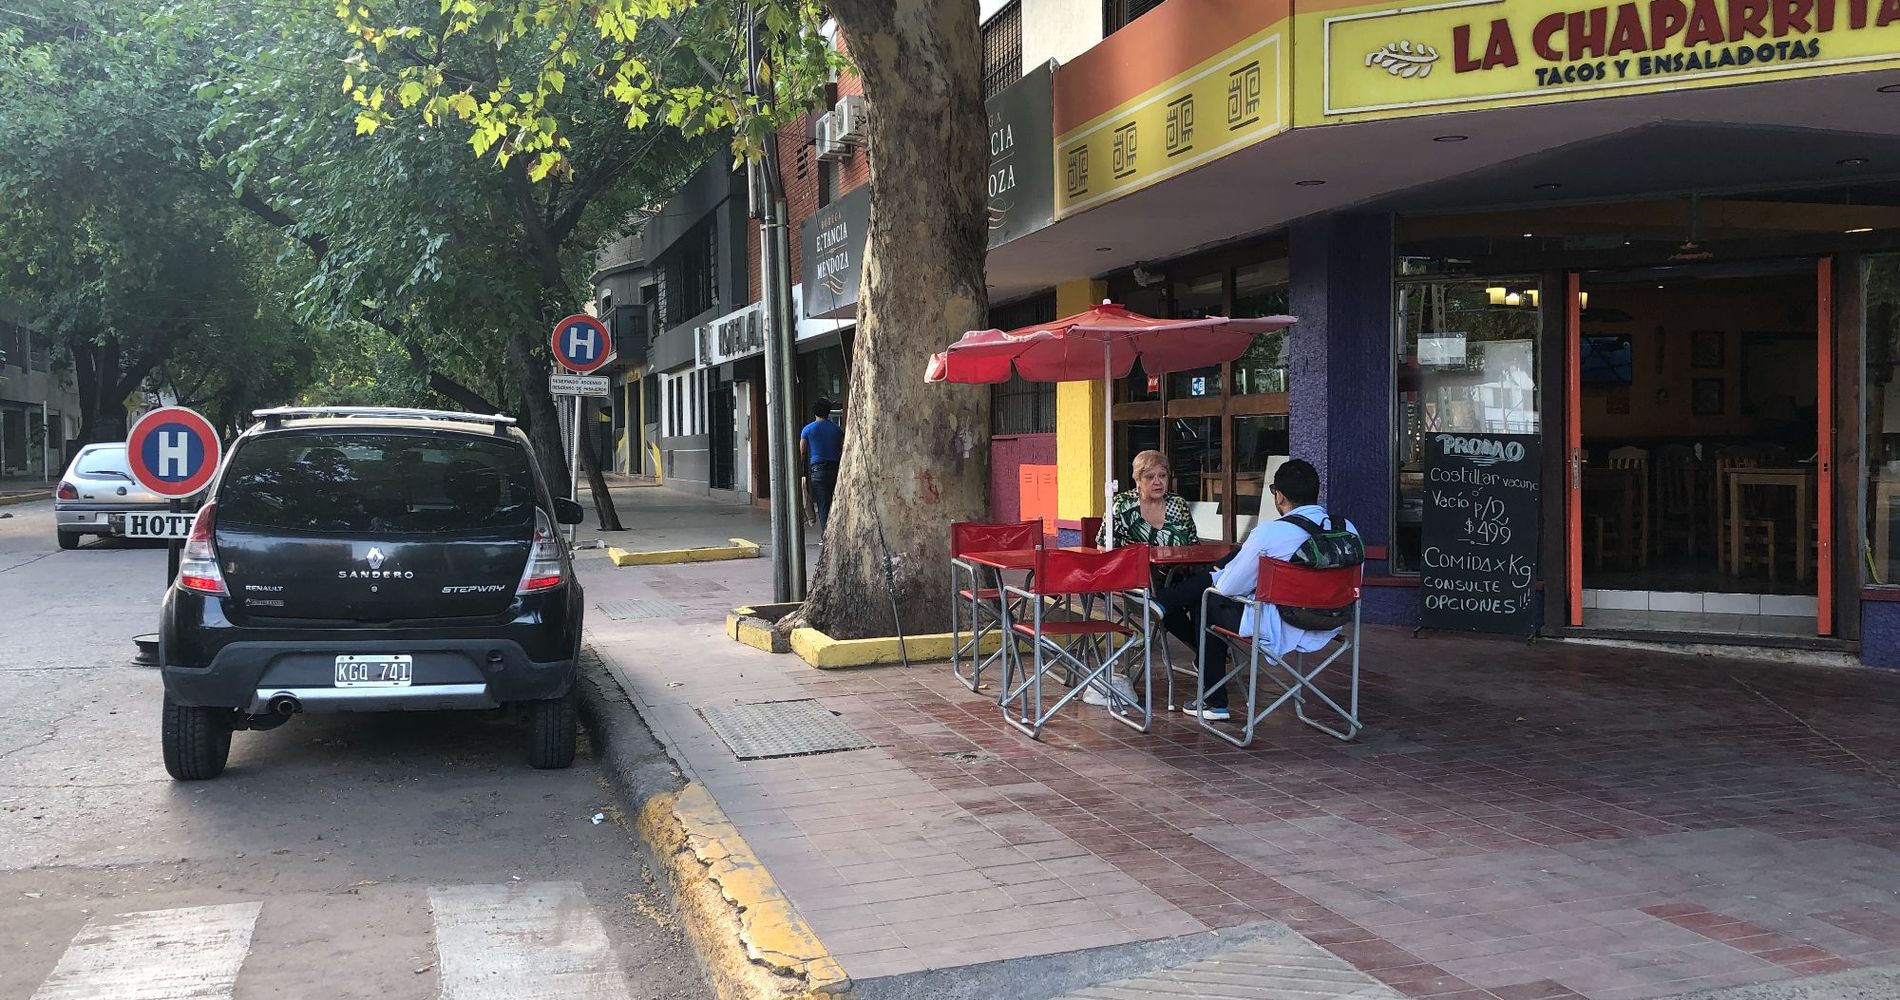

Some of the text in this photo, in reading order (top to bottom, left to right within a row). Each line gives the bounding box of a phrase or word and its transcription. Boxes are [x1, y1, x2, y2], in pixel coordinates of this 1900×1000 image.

[1452, 18, 1519, 74] LA
[1535, 37, 1821, 87] TACOS Y ENSALADOTAS
[817, 250, 850, 280] MENDOZA
[569, 327, 595, 360] H
[158, 431, 188, 477] H
[1435, 433, 1525, 462] PROMO
[1430, 466, 1500, 485] Costillar
[338, 570, 415, 579] SANDERO
[1423, 576, 1501, 593] CONSULTE
[441, 585, 505, 594] STEPWAY
[379, 663, 409, 681] 741
